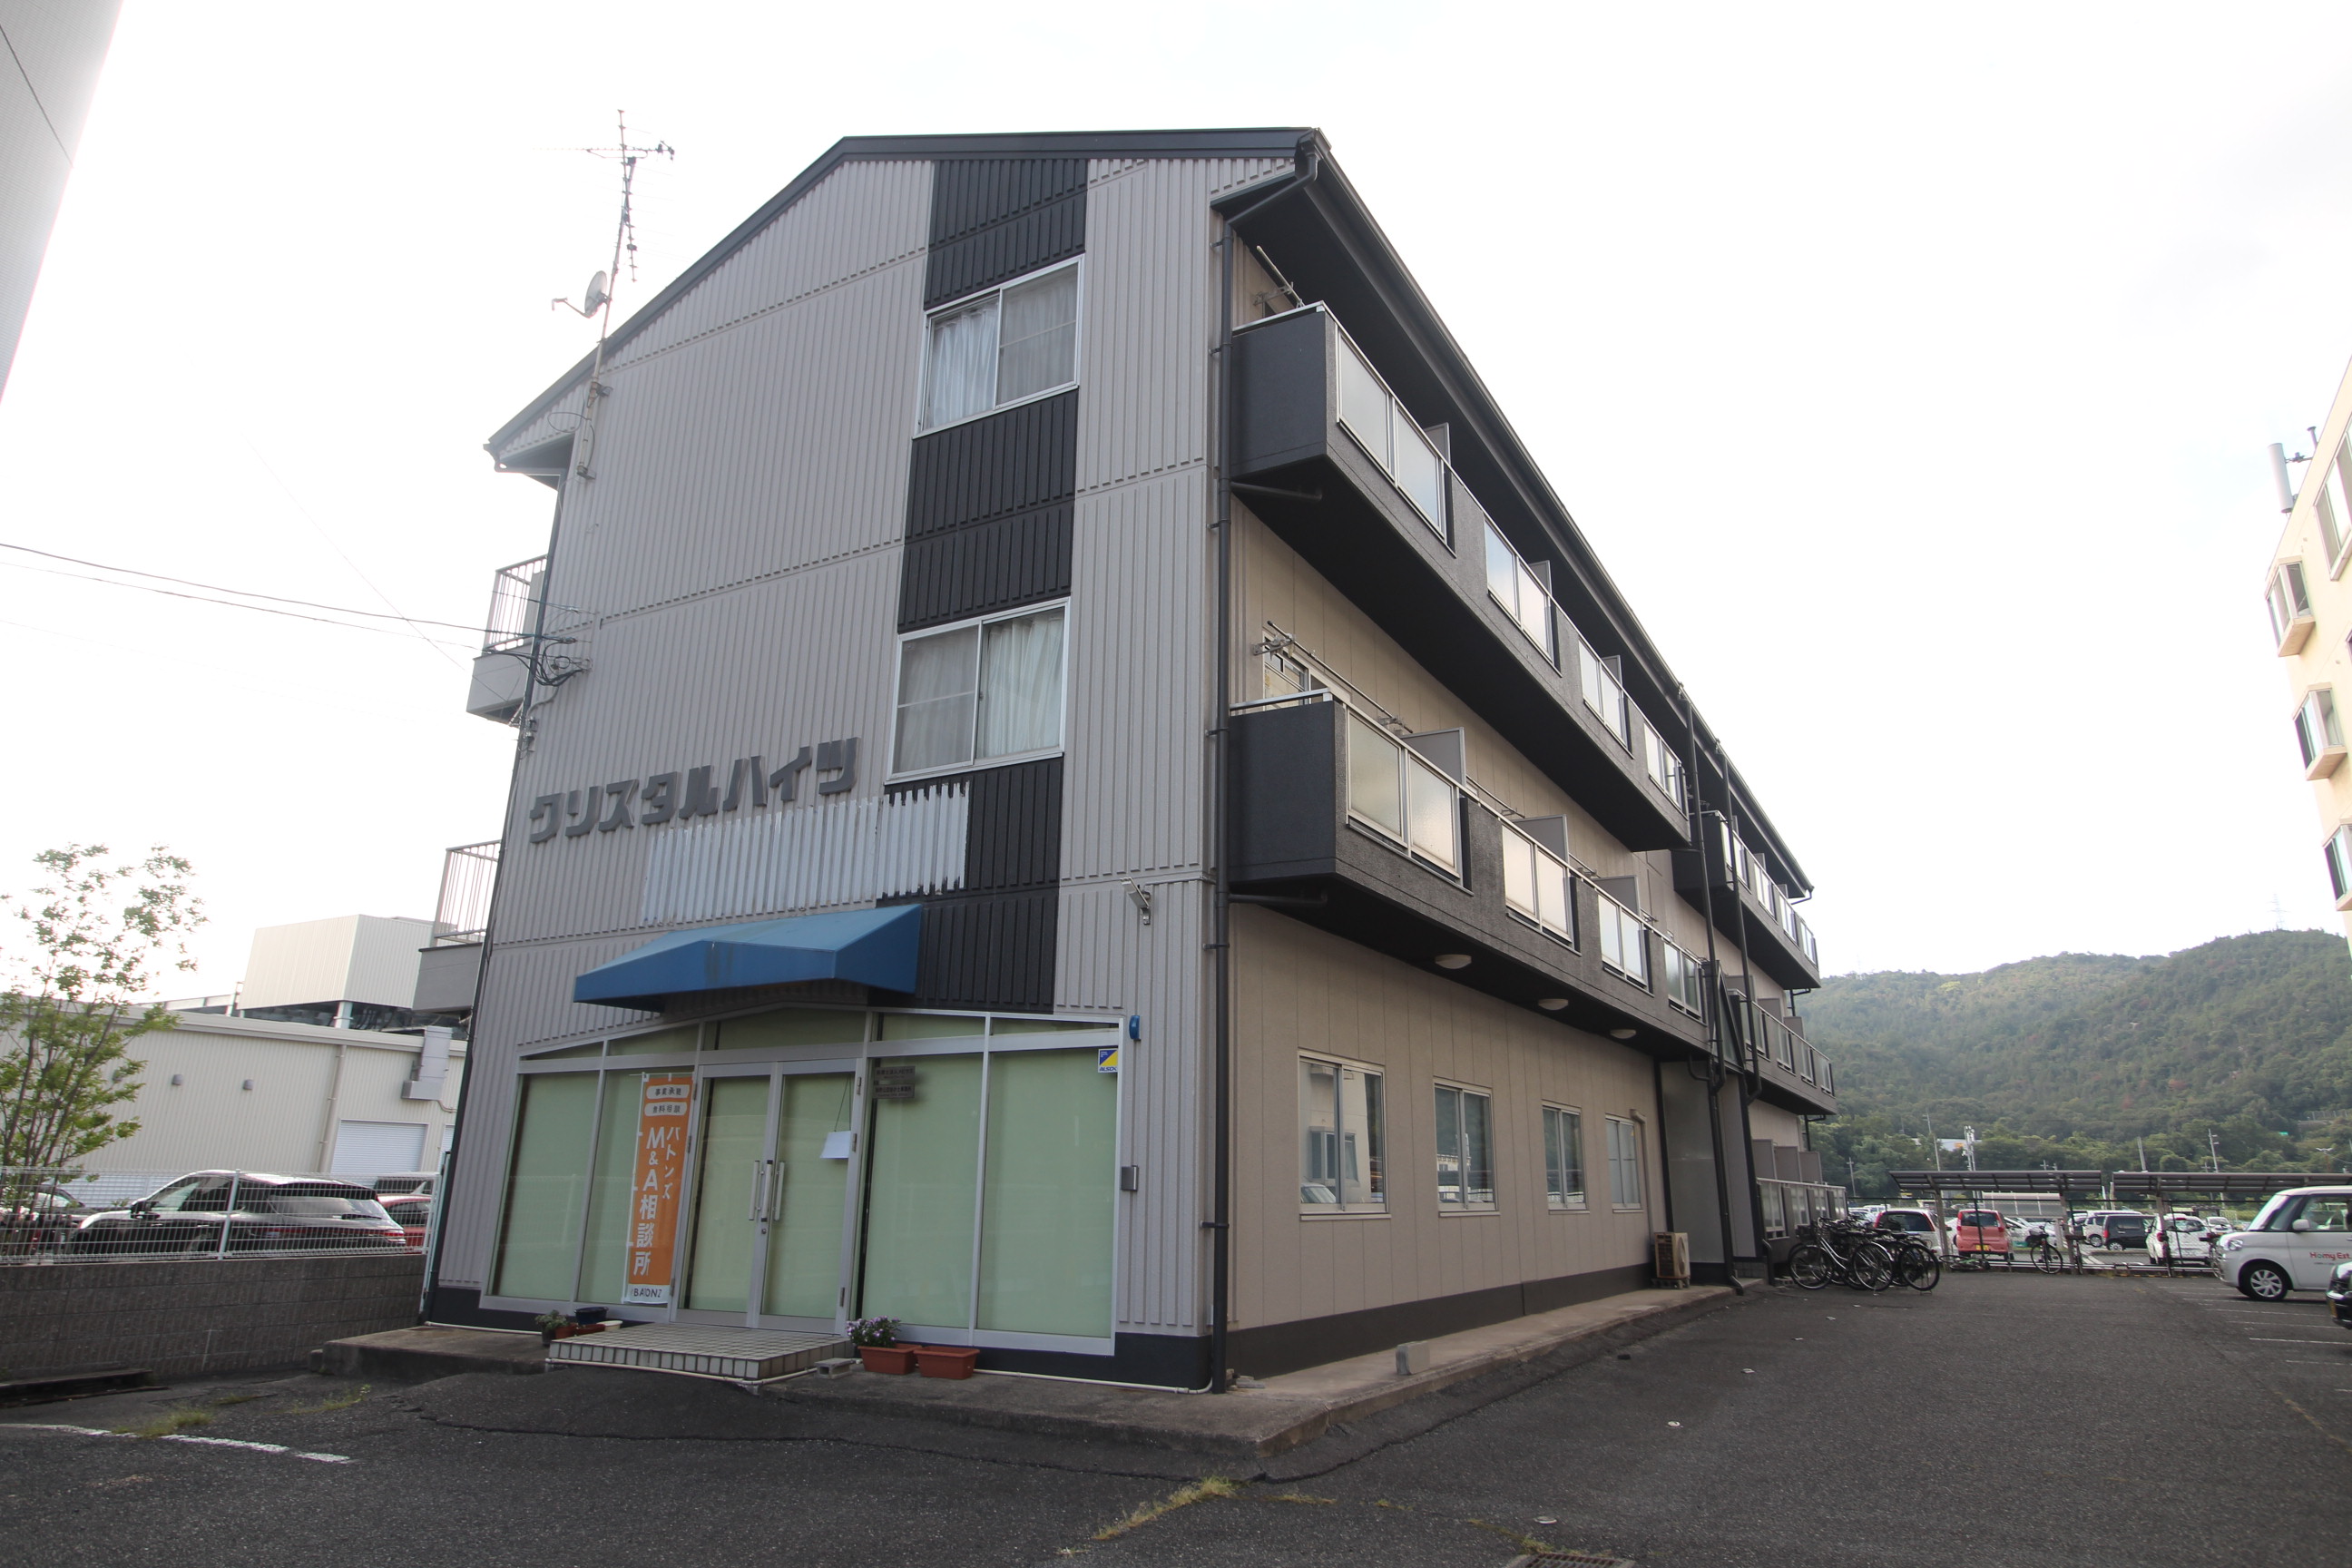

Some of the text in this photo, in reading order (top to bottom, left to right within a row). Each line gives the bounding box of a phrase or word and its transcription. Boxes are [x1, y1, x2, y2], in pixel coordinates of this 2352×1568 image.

[529, 737, 861, 844] クリスタルハイツ
[633, 1126, 665, 1276] M&A相談所
[662, 1126, 681, 1200] バトンズ
